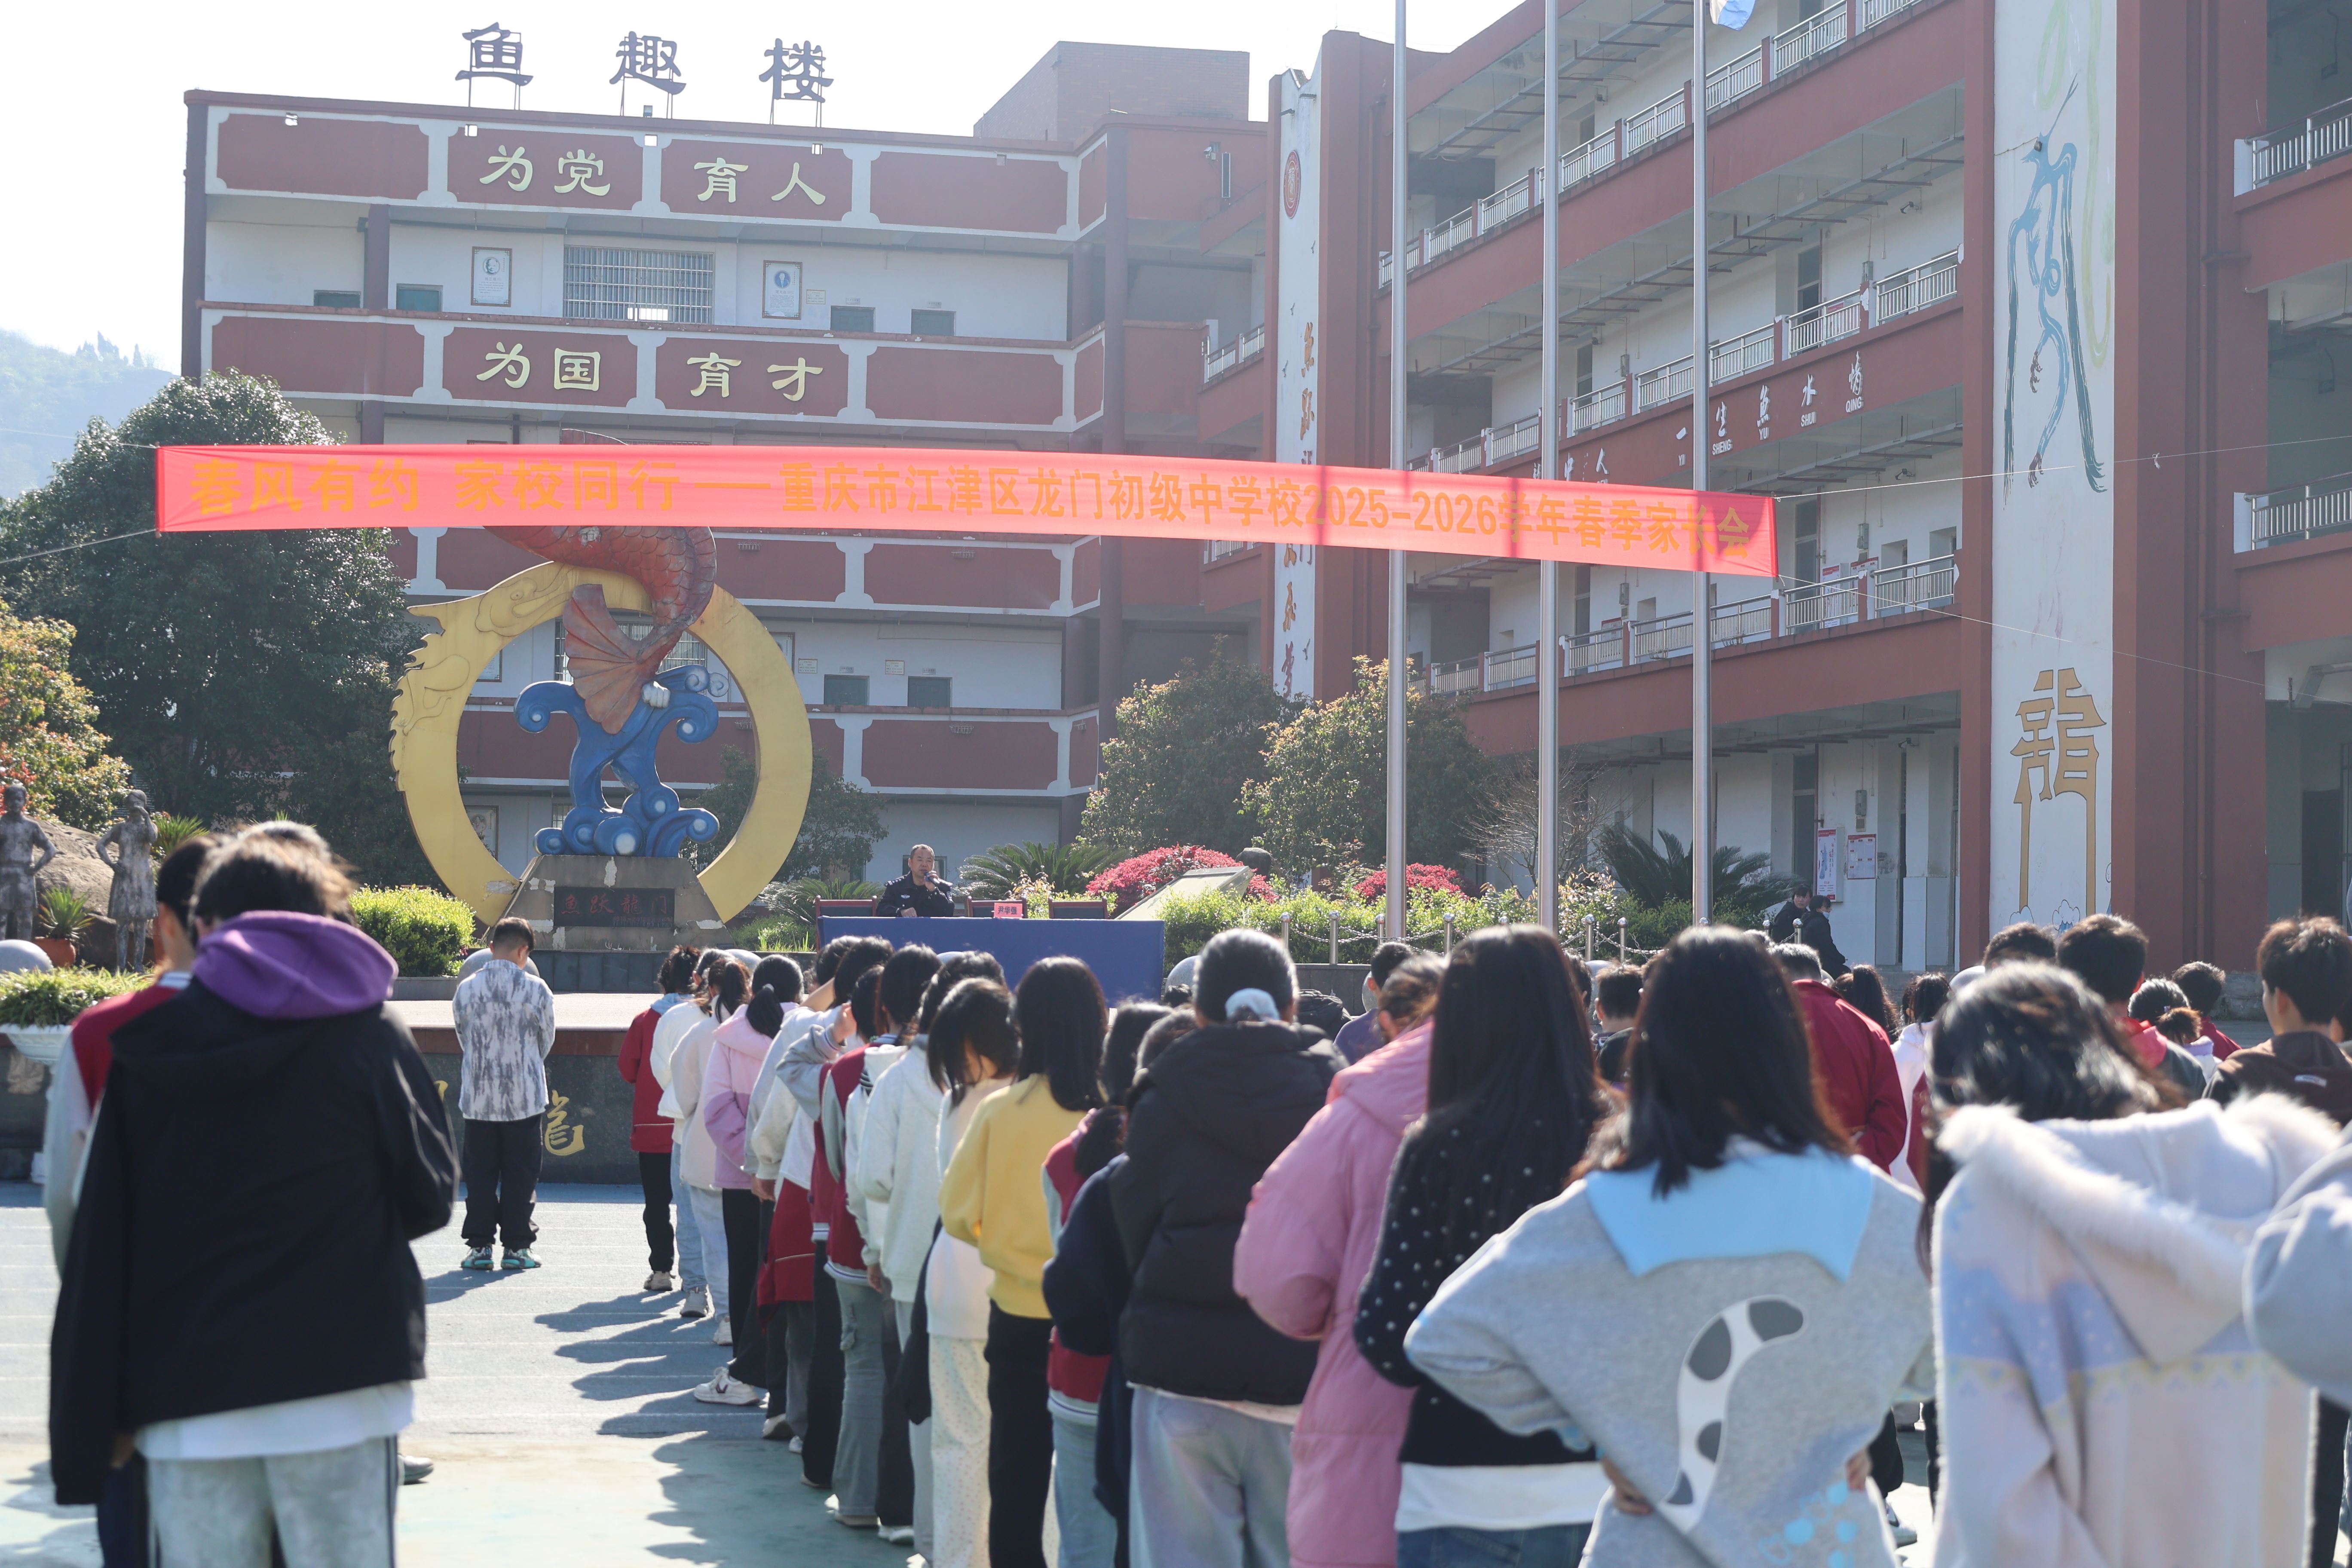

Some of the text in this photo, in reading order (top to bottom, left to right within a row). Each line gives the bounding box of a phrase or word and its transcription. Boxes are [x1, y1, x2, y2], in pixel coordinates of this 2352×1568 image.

[455, 22, 834, 103] 鱼趣楼
[479, 144, 826, 205] 为党育人
[476, 342, 824, 402] 为国育才
[1678, 396, 1864, 466] YI SHENG YU SHUI QING
[190, 457, 419, 515] 春风有约
